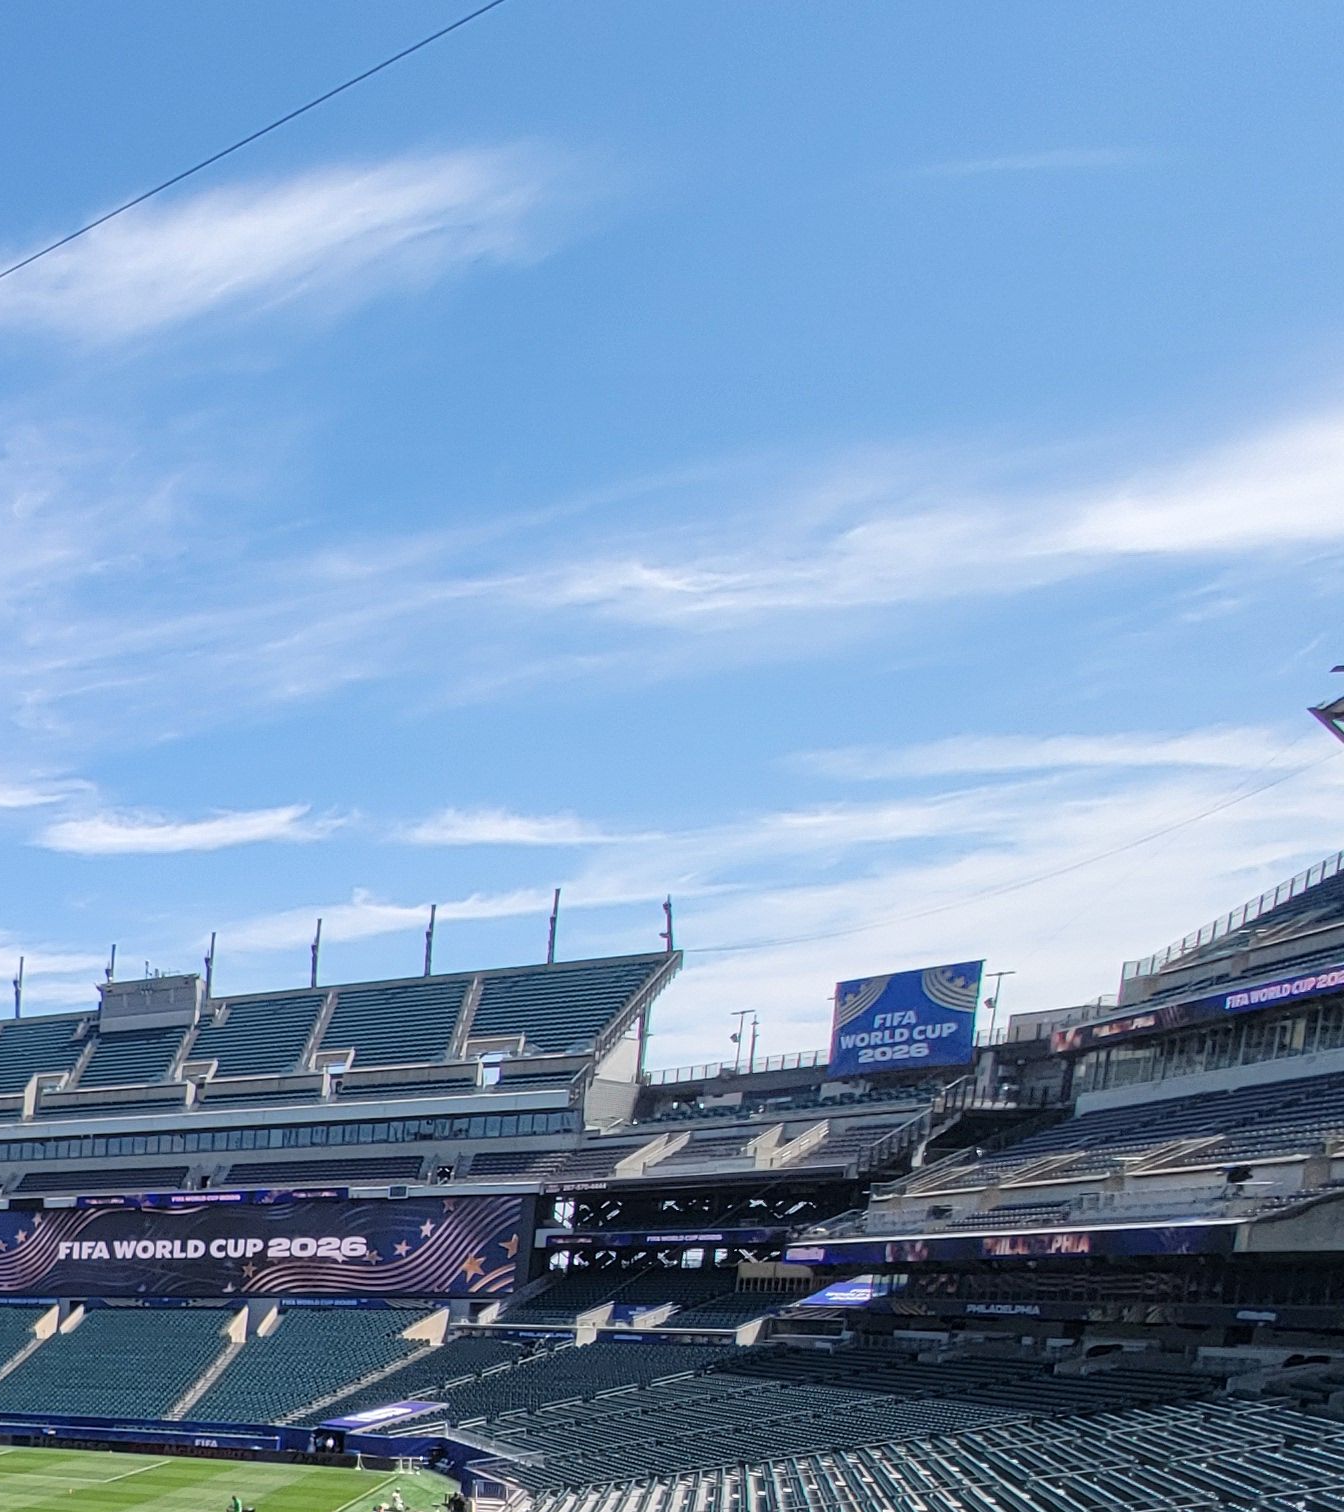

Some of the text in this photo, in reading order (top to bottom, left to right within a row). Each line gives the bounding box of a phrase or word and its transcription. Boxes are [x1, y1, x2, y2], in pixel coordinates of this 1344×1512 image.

[1316, 970, 1344, 989] 202
[874, 1010, 917, 1029] FIFA
[840, 1023, 958, 1049] WORLD CUP
[858, 1043, 930, 1064] 2026
[59, 1236, 368, 1260] FIFA WORLD CUP 2026
[983, 1233, 1090, 1256] PHILAPHIA
[966, 1303, 1041, 1316] PHILADELPHIA
[194, 1439, 218, 1448] FIFA
